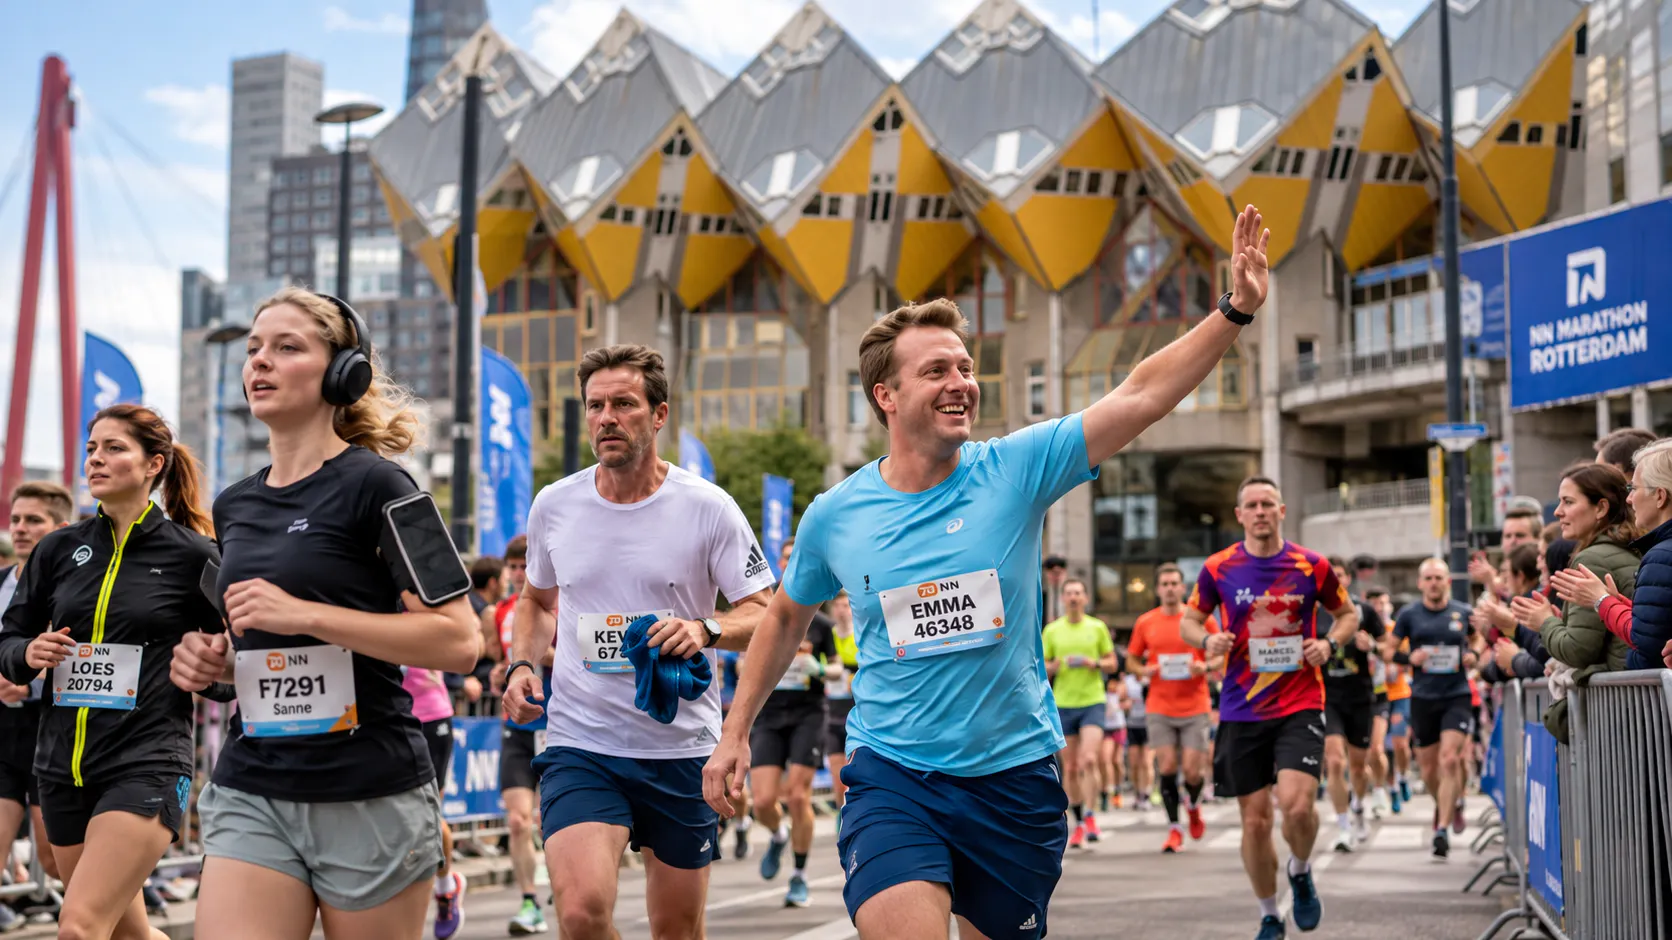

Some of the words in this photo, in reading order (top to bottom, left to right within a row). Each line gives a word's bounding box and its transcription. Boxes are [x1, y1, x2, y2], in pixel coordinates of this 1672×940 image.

[1530, 322, 1554, 347] NN
[1556, 300, 1648, 341] MARATHON
[1530, 325, 1648, 374] ROTTERDAM
[940, 581, 960, 592] NN
[911, 594, 976, 620] EMMA
[914, 614, 975, 638] 46348
[594, 630, 628, 643] KEV
[94, 647, 110, 656] NN
[288, 654, 308, 666] NN
[71, 661, 115, 676] LOES
[67, 678, 113, 692] 20794
[259, 675, 326, 699] F7291
[273, 703, 312, 715] Sanne
